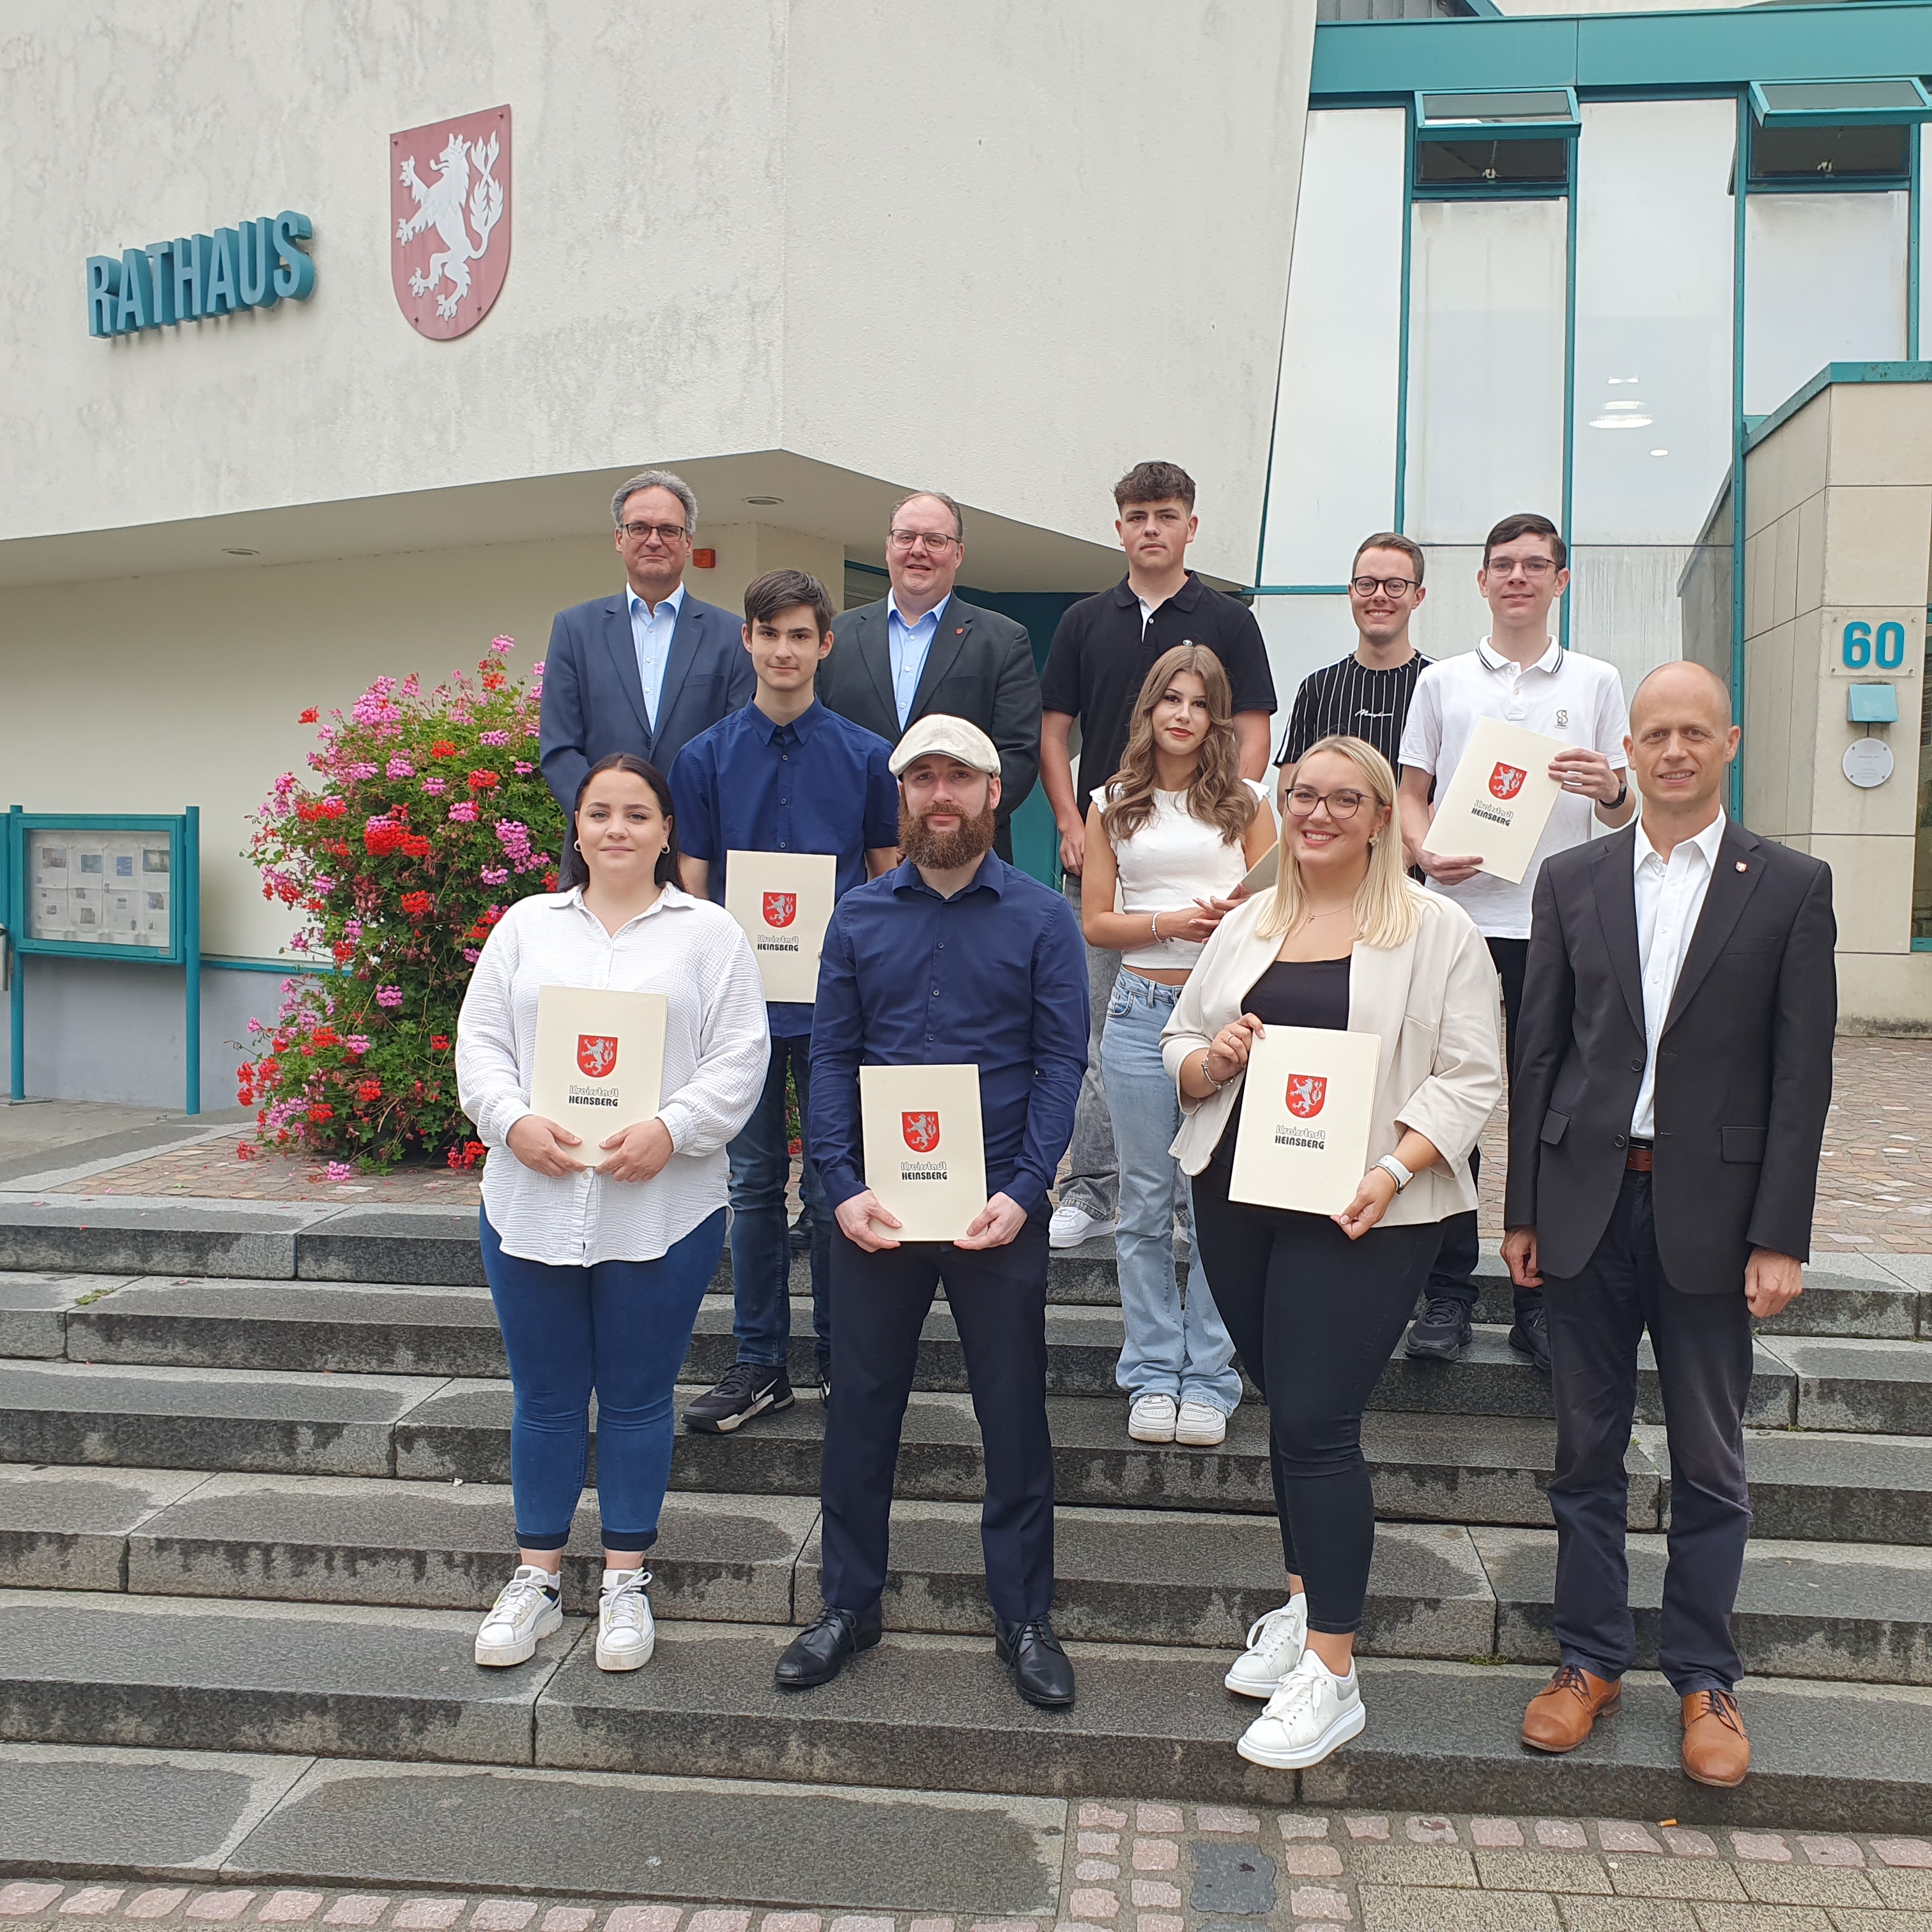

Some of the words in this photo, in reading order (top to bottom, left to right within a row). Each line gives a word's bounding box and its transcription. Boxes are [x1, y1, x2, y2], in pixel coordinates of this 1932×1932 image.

[86, 210, 314, 339] RATHAUS
[1843, 621, 1905, 669] 60
[1471, 808, 1511, 826] HEINSBERG
[757, 943, 799, 951] HEINSBERG
[569, 1085, 618, 1097] Kreisstadt
[569, 1095, 618, 1107] HEINSBERG
[1276, 1124, 1326, 1140] Kreisstadt
[1275, 1135, 1324, 1149] HEINSBERG
[901, 1162, 947, 1170] Kreisstadt
[901, 1171, 947, 1180] HEINSBERG
